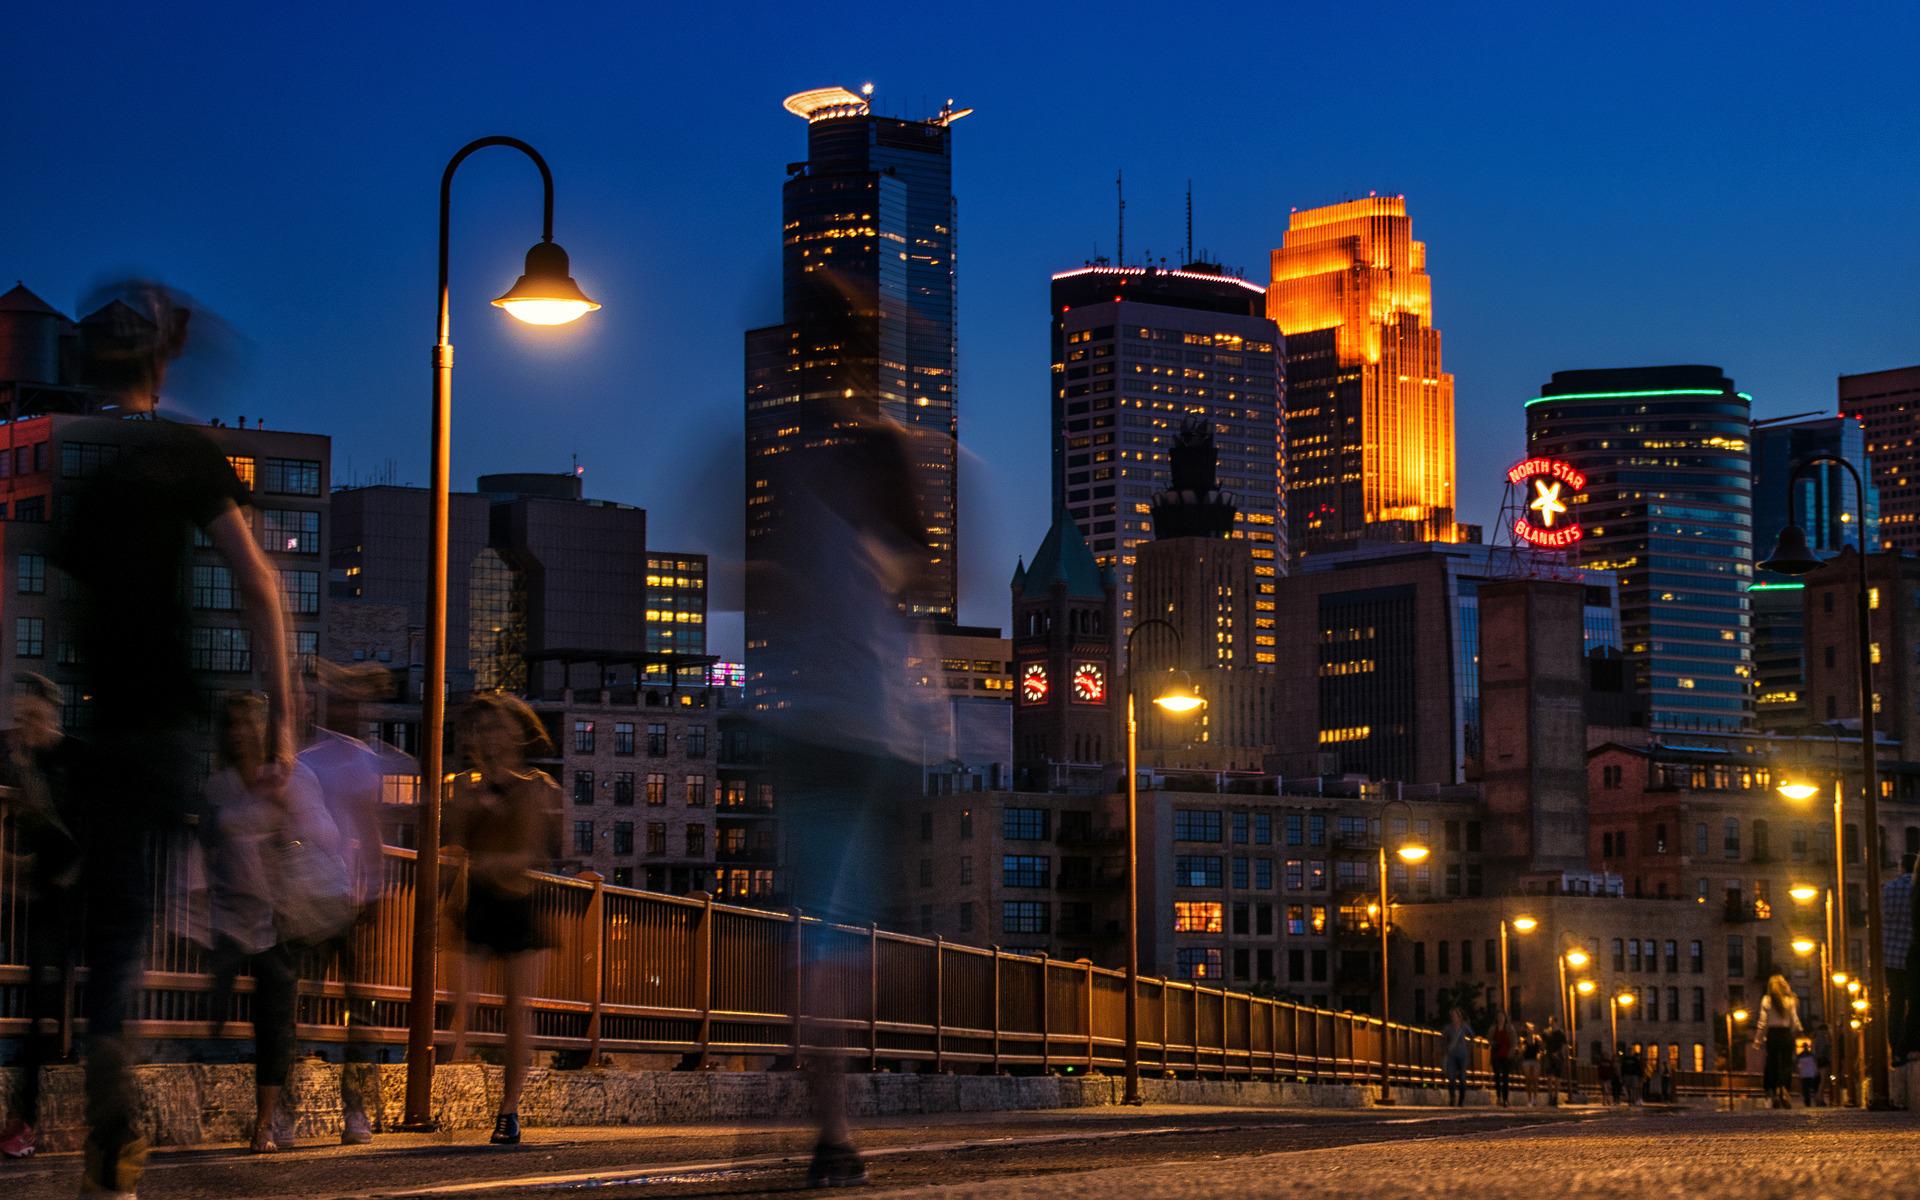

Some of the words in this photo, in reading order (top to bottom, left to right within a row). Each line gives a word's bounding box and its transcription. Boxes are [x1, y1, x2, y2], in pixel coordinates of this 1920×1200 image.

[1508, 460, 1550, 483] NORTH
[1552, 462, 1584, 489] STAR
[1515, 520, 1580, 545] BLANKETS
